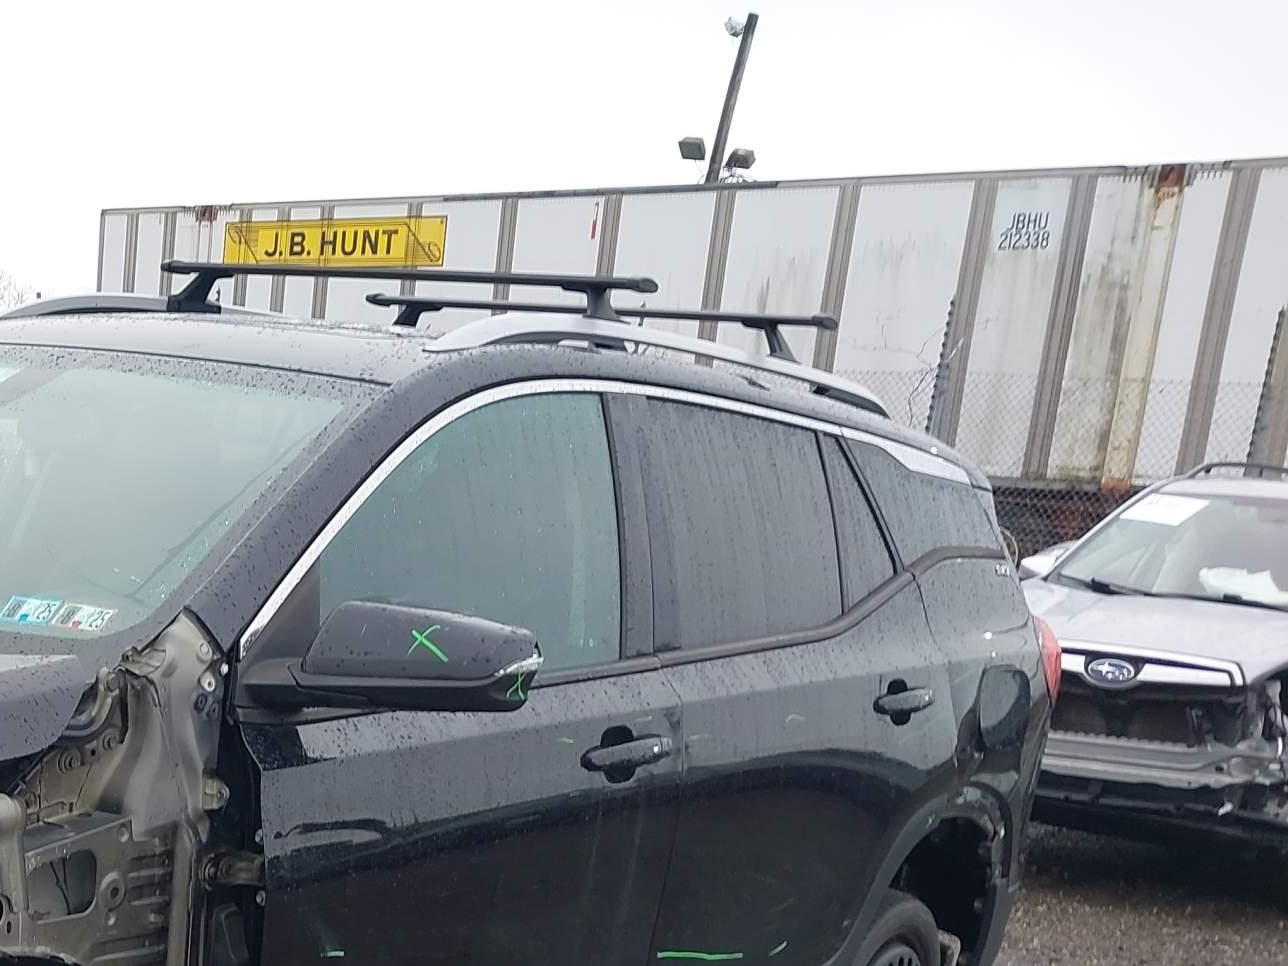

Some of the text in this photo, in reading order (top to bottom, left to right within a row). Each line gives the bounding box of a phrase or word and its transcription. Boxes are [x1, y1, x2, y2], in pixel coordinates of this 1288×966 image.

[1009, 212, 1049, 231] JBHU
[320, 228, 399, 257] HUNT
[998, 231, 1050, 250] 212338
